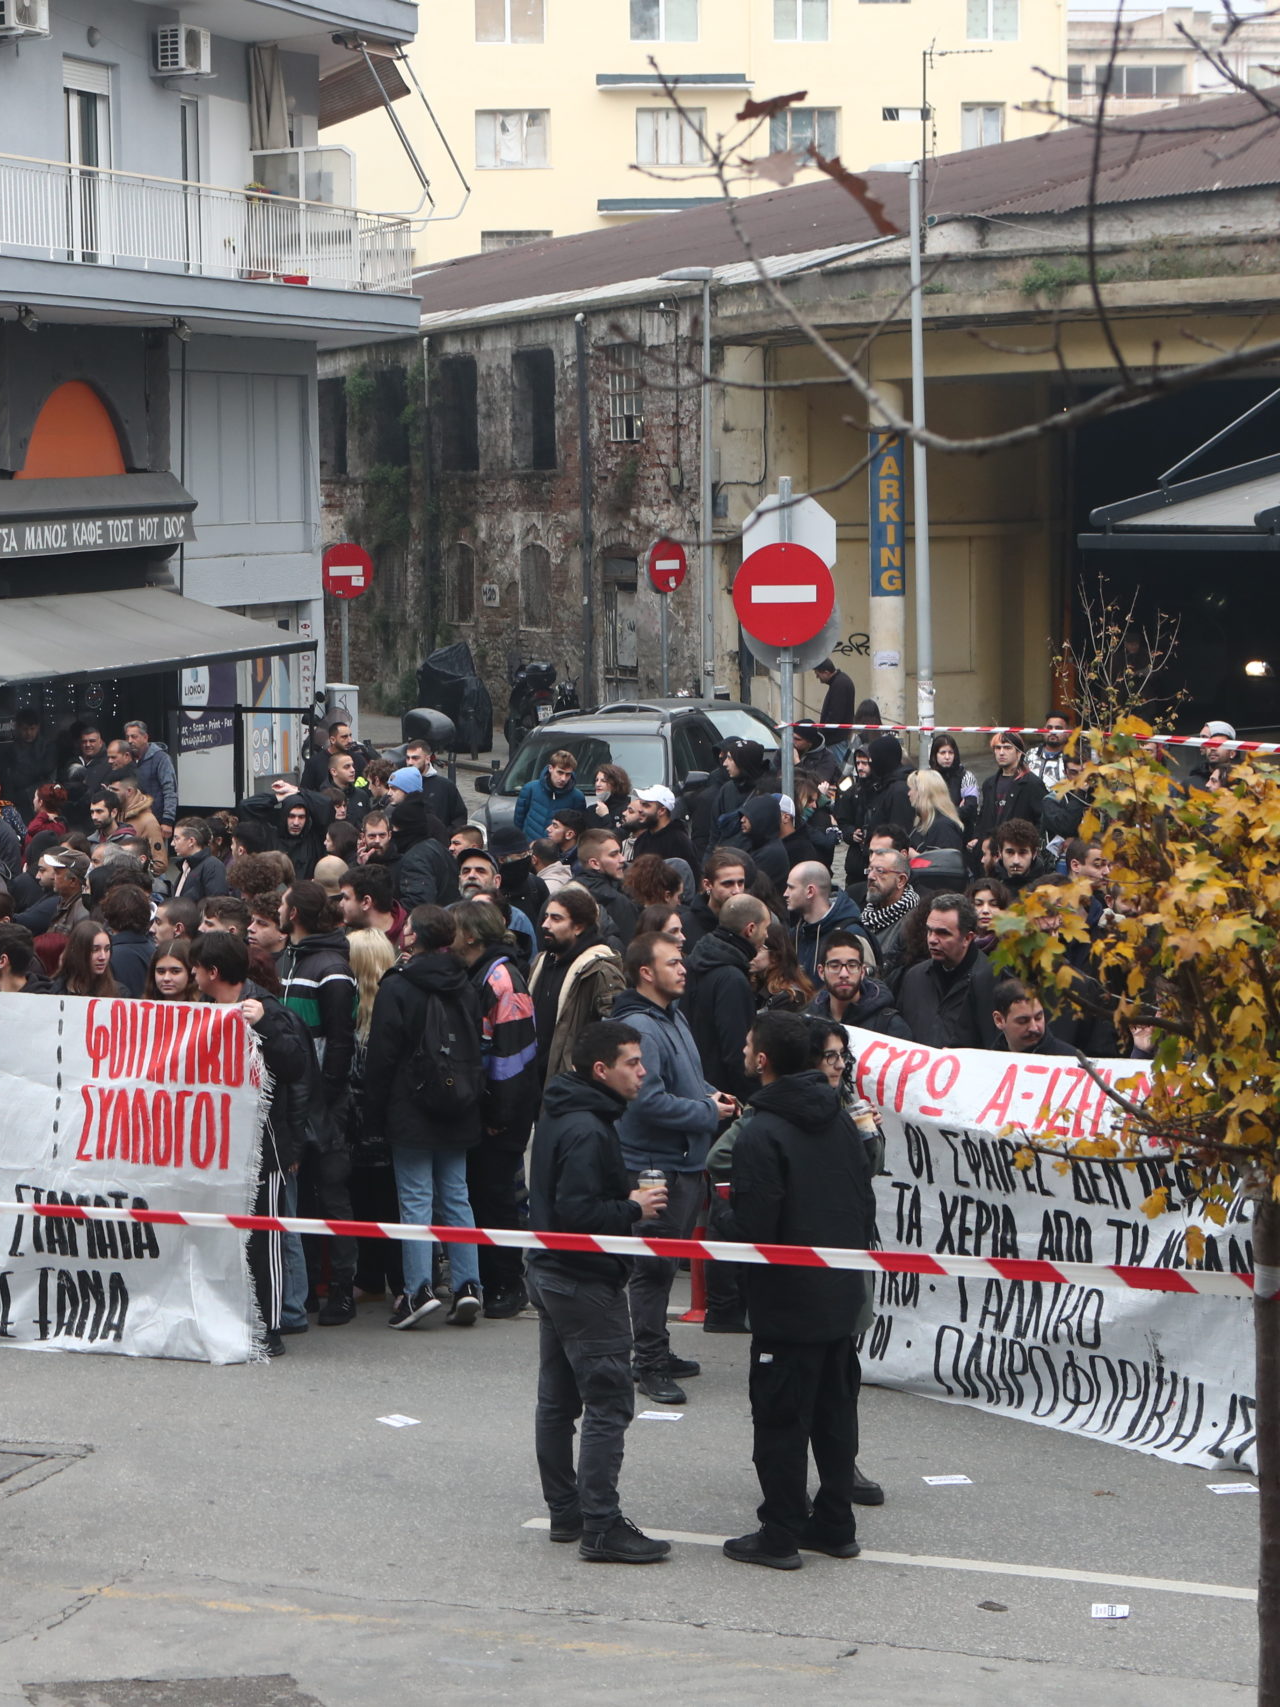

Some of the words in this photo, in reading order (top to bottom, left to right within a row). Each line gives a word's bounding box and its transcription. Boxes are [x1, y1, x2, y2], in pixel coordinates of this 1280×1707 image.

[24, 523, 68, 550] ΜΑΝΟΣ
[72, 520, 103, 546] ΚΑΦΕ
[107, 518, 134, 543] ΤΟΣΤ
[138, 517, 159, 541] HOT
[878, 433, 902, 591] PARKING
